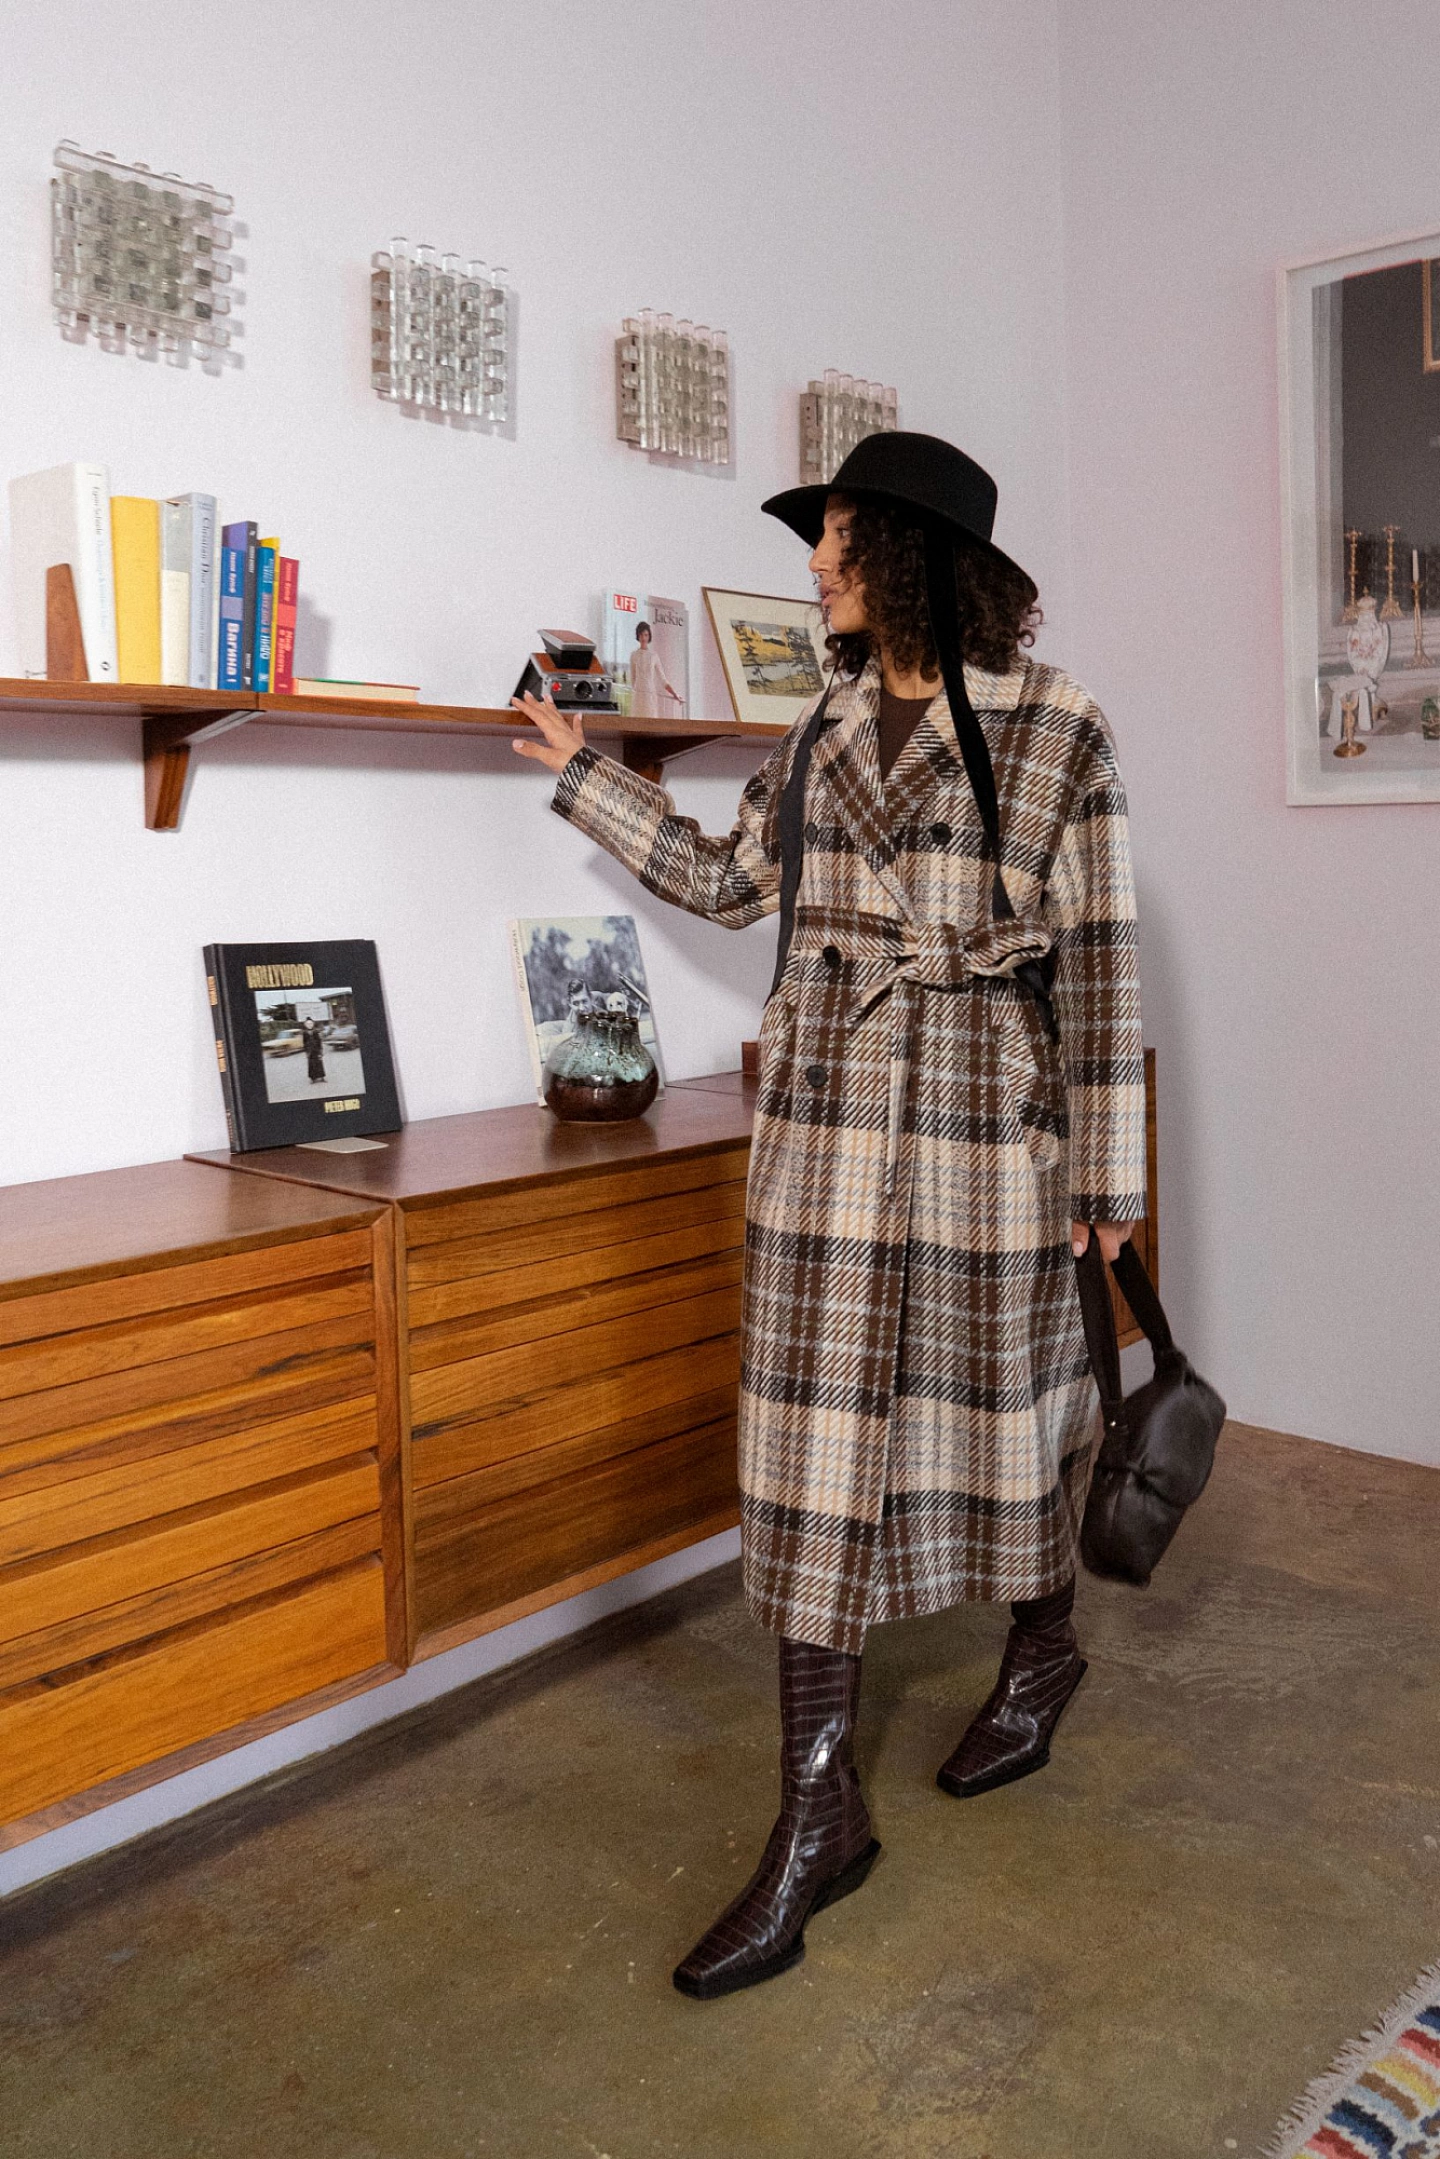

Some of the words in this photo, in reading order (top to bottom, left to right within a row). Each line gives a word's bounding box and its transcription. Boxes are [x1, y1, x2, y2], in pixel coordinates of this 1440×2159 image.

[200, 517, 211, 559] Christian
[614, 595, 637, 612] LIFE
[653, 608, 684, 626] Jackie
[226, 622, 240, 676] Вагина
[246, 964, 314, 989] HOLLYWOOD
